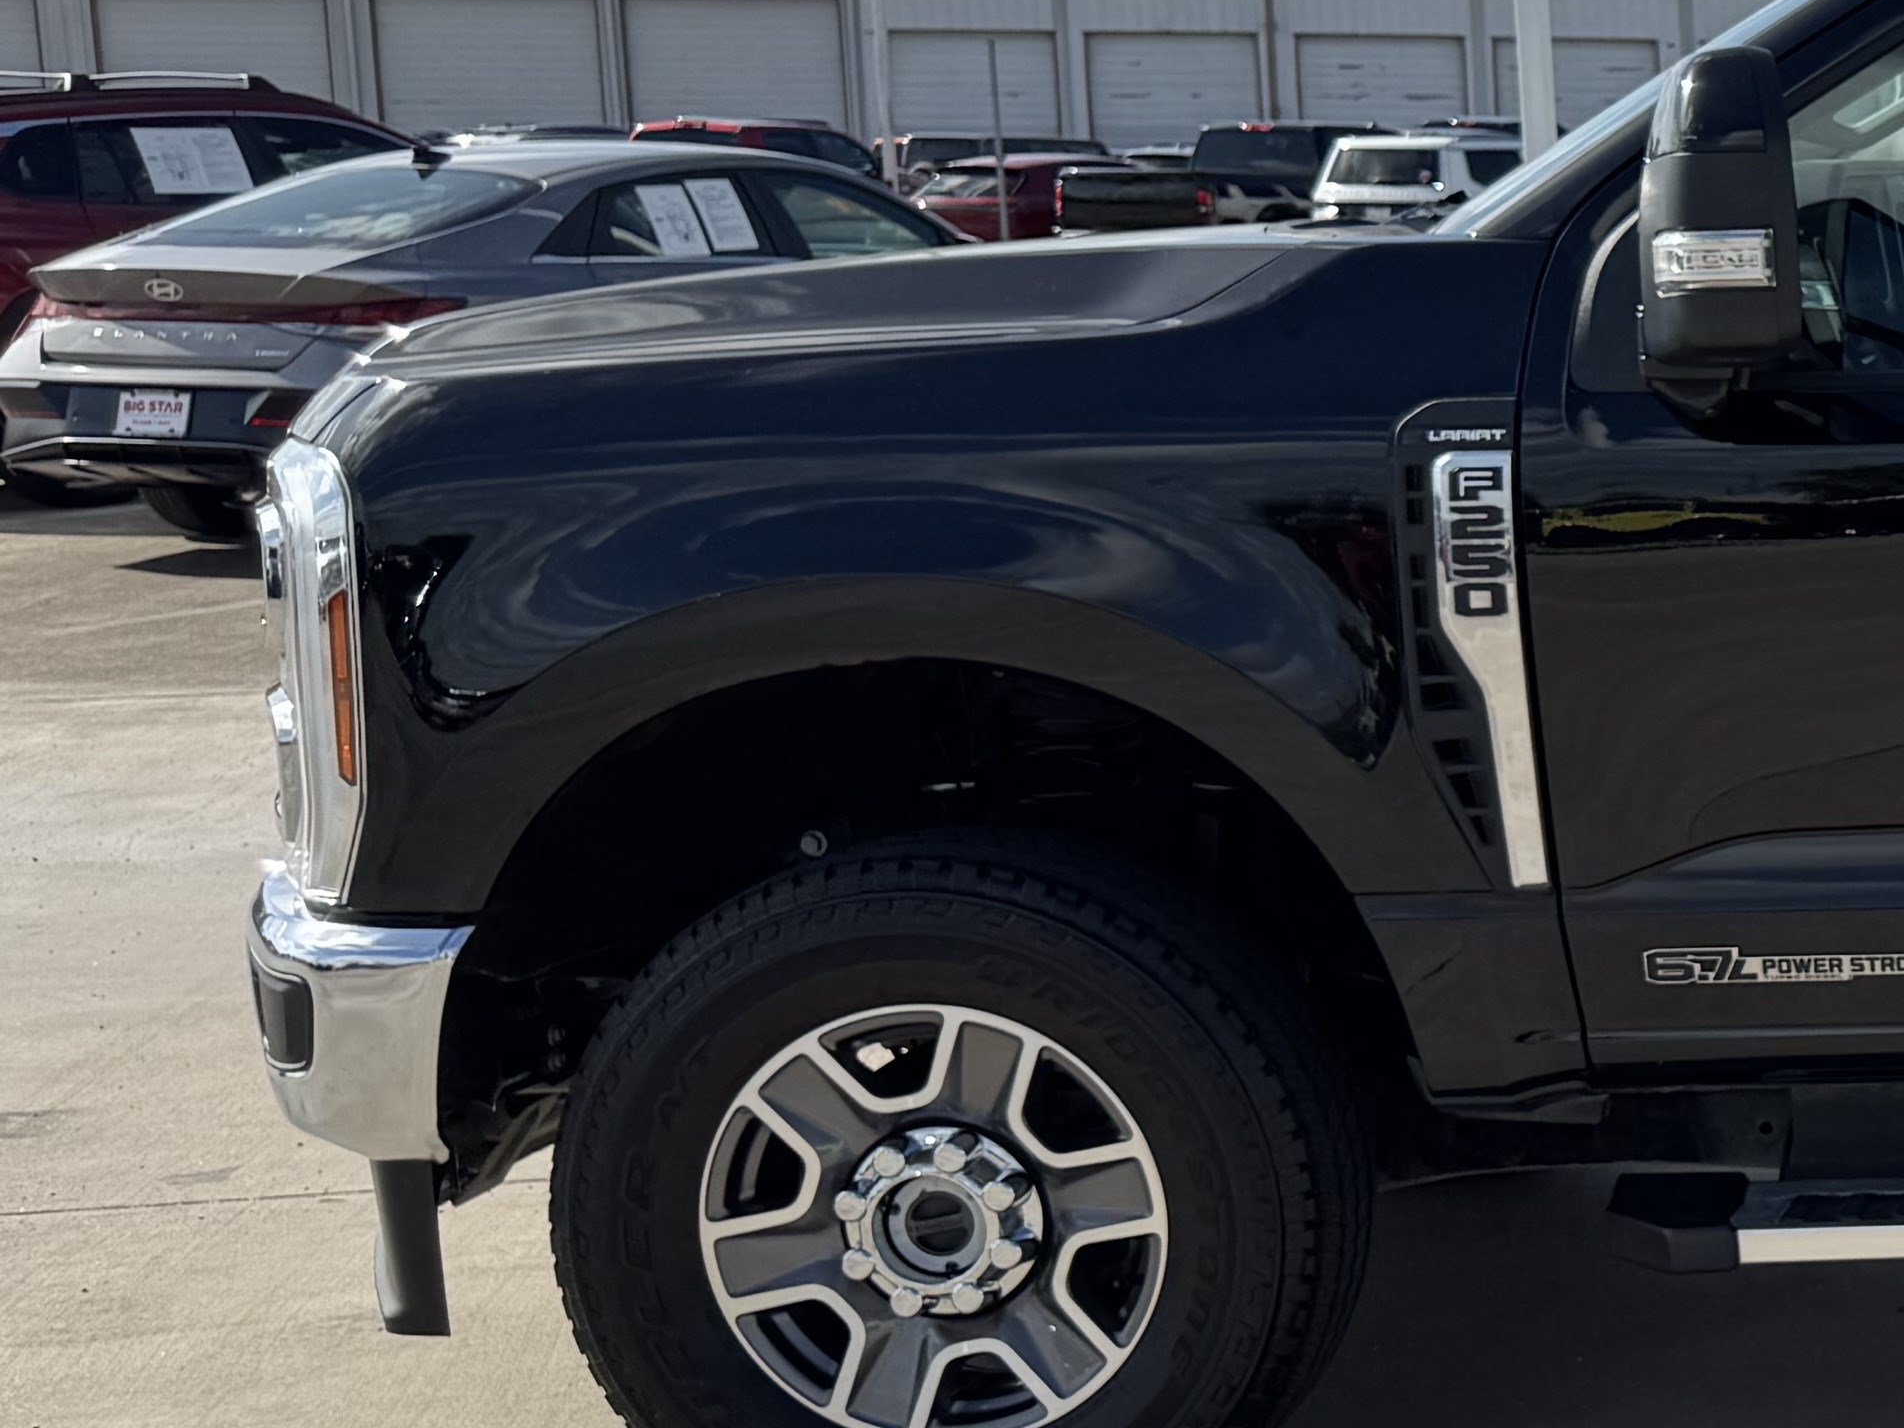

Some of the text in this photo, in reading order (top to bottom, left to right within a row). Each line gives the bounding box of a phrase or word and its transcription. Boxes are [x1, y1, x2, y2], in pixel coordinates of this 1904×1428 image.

[123, 399, 183, 414] BIG STAR
[1428, 428, 1507, 442] LARIAT
[1644, 948, 1758, 984] 6.7L
[1763, 957, 1844, 975] POWER
